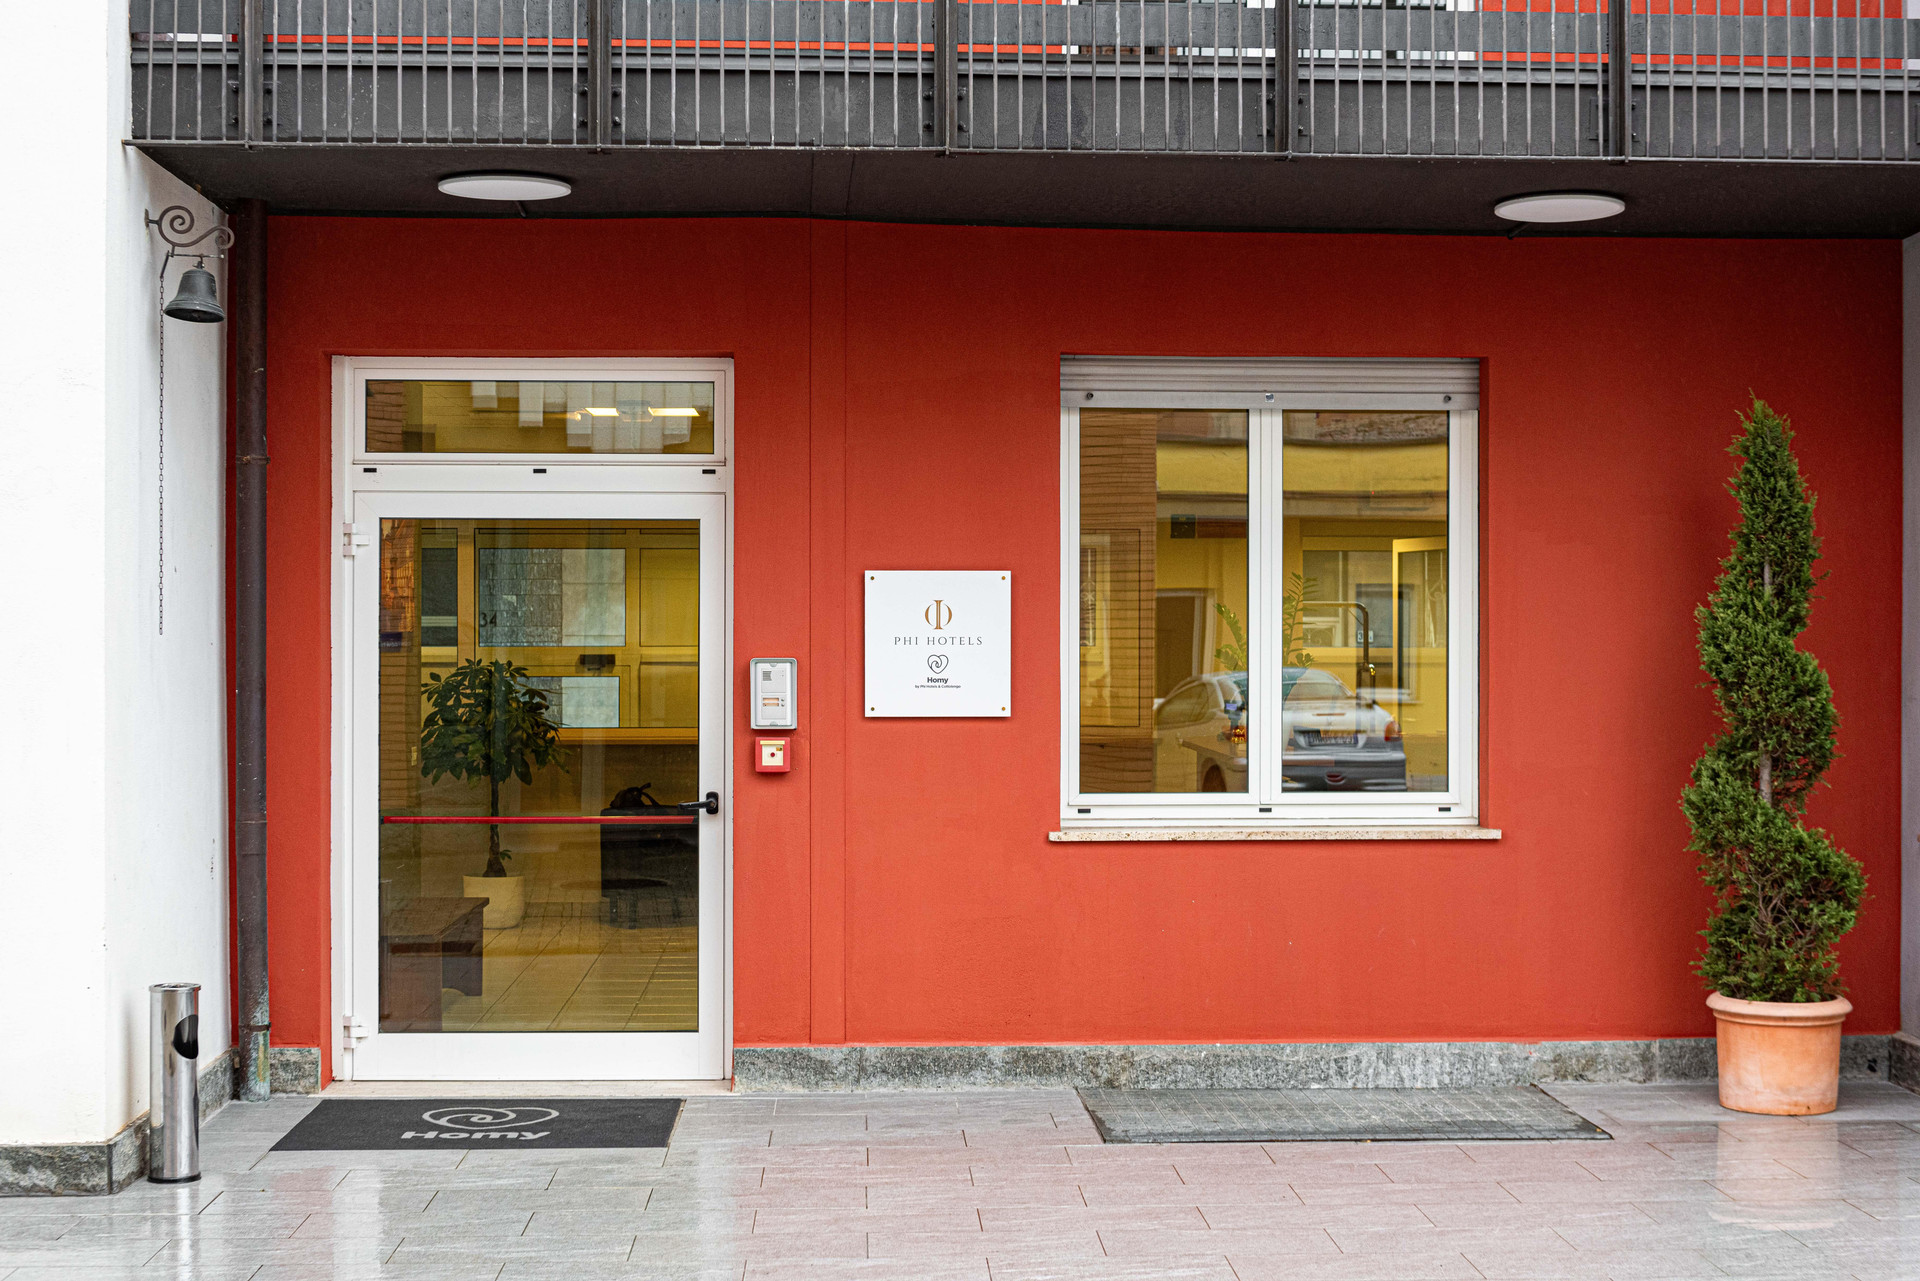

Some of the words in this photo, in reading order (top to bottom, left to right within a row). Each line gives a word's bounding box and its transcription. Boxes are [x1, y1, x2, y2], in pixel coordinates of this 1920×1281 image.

[480, 611, 497, 627] 34
[894, 636, 919, 646] PHI
[927, 636, 983, 646] HOTELS
[400, 1131, 551, 1140] Homy
